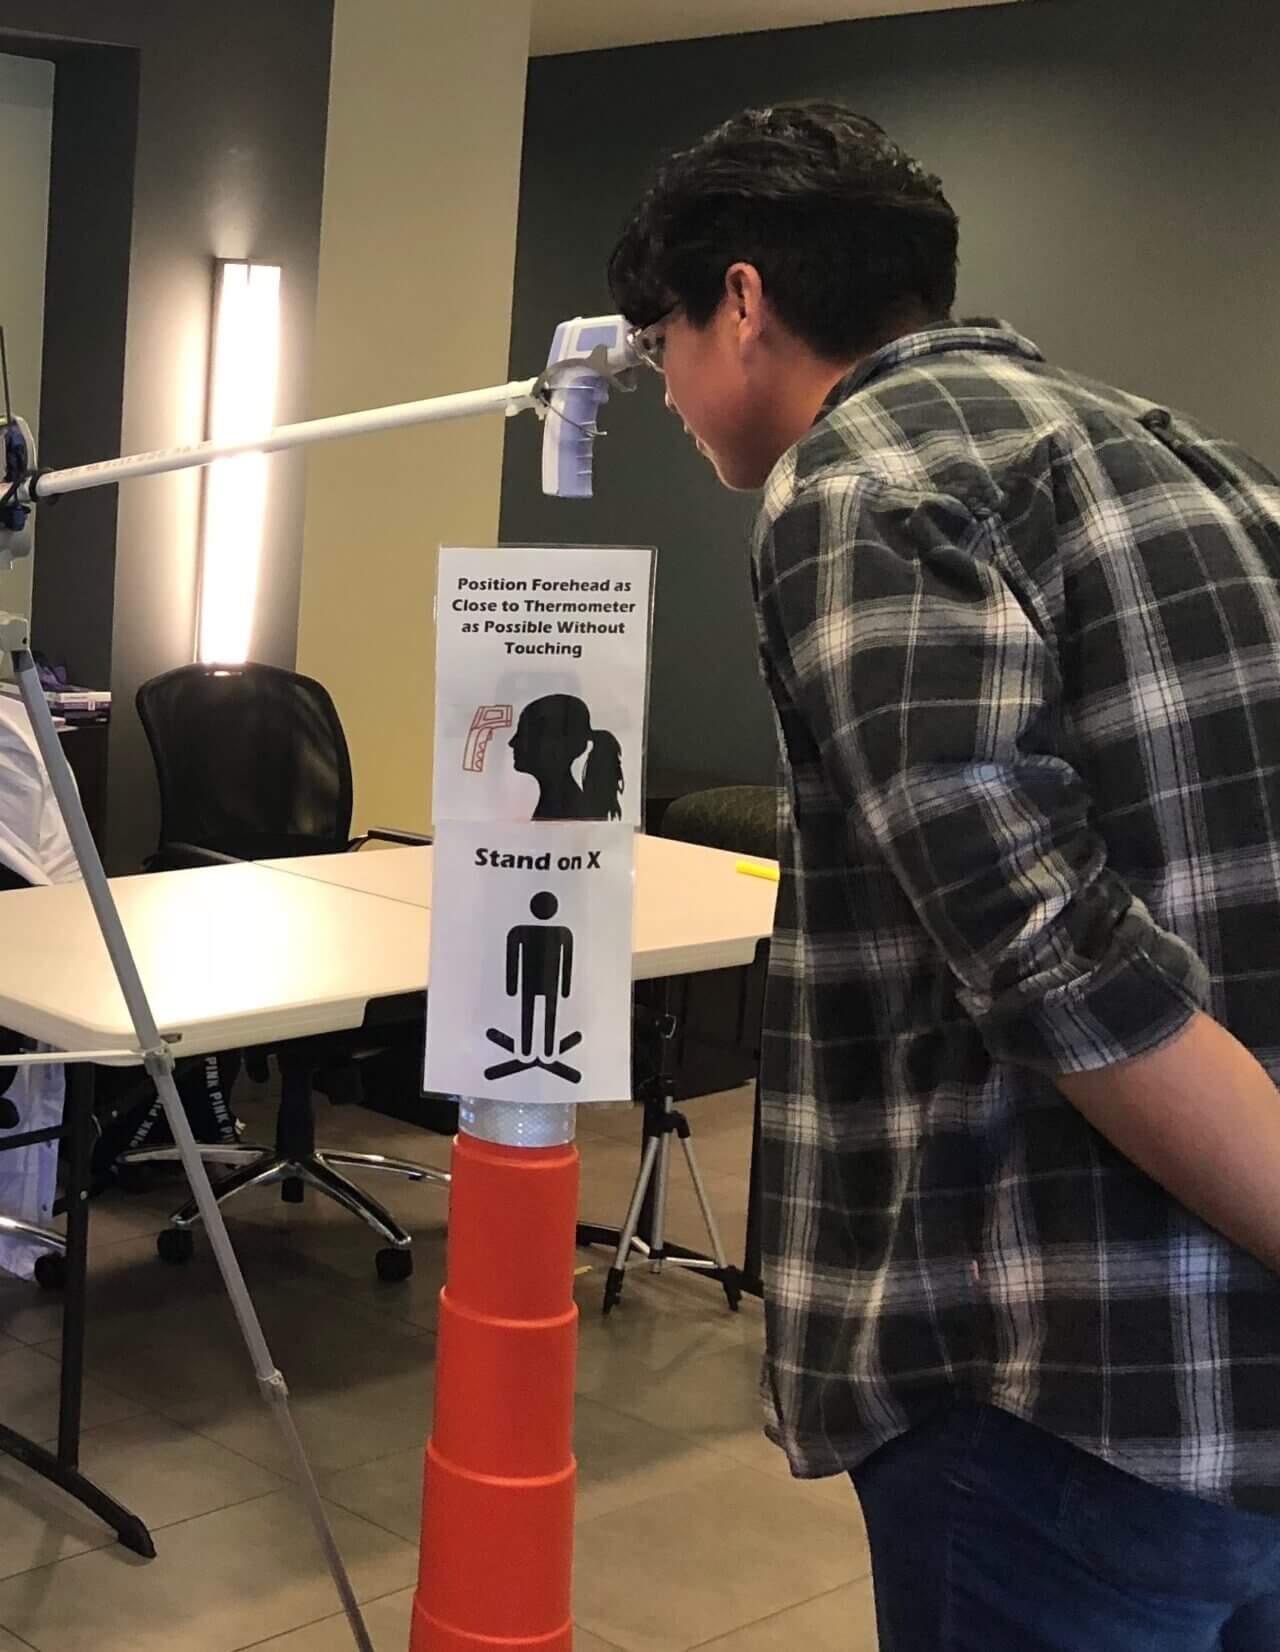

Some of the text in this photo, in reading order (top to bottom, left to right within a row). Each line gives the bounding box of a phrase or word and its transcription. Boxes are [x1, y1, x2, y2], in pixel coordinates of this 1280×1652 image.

[457, 577, 632, 592] Position Forehead as
[451, 598, 636, 613] Close to Thermometer
[461, 620, 625, 634] as Possible Without
[503, 641, 583, 659] Touching
[474, 847, 601, 871] Stand on X
[205, 1056, 219, 1088] PINK
[209, 1091, 230, 1123] PINK
